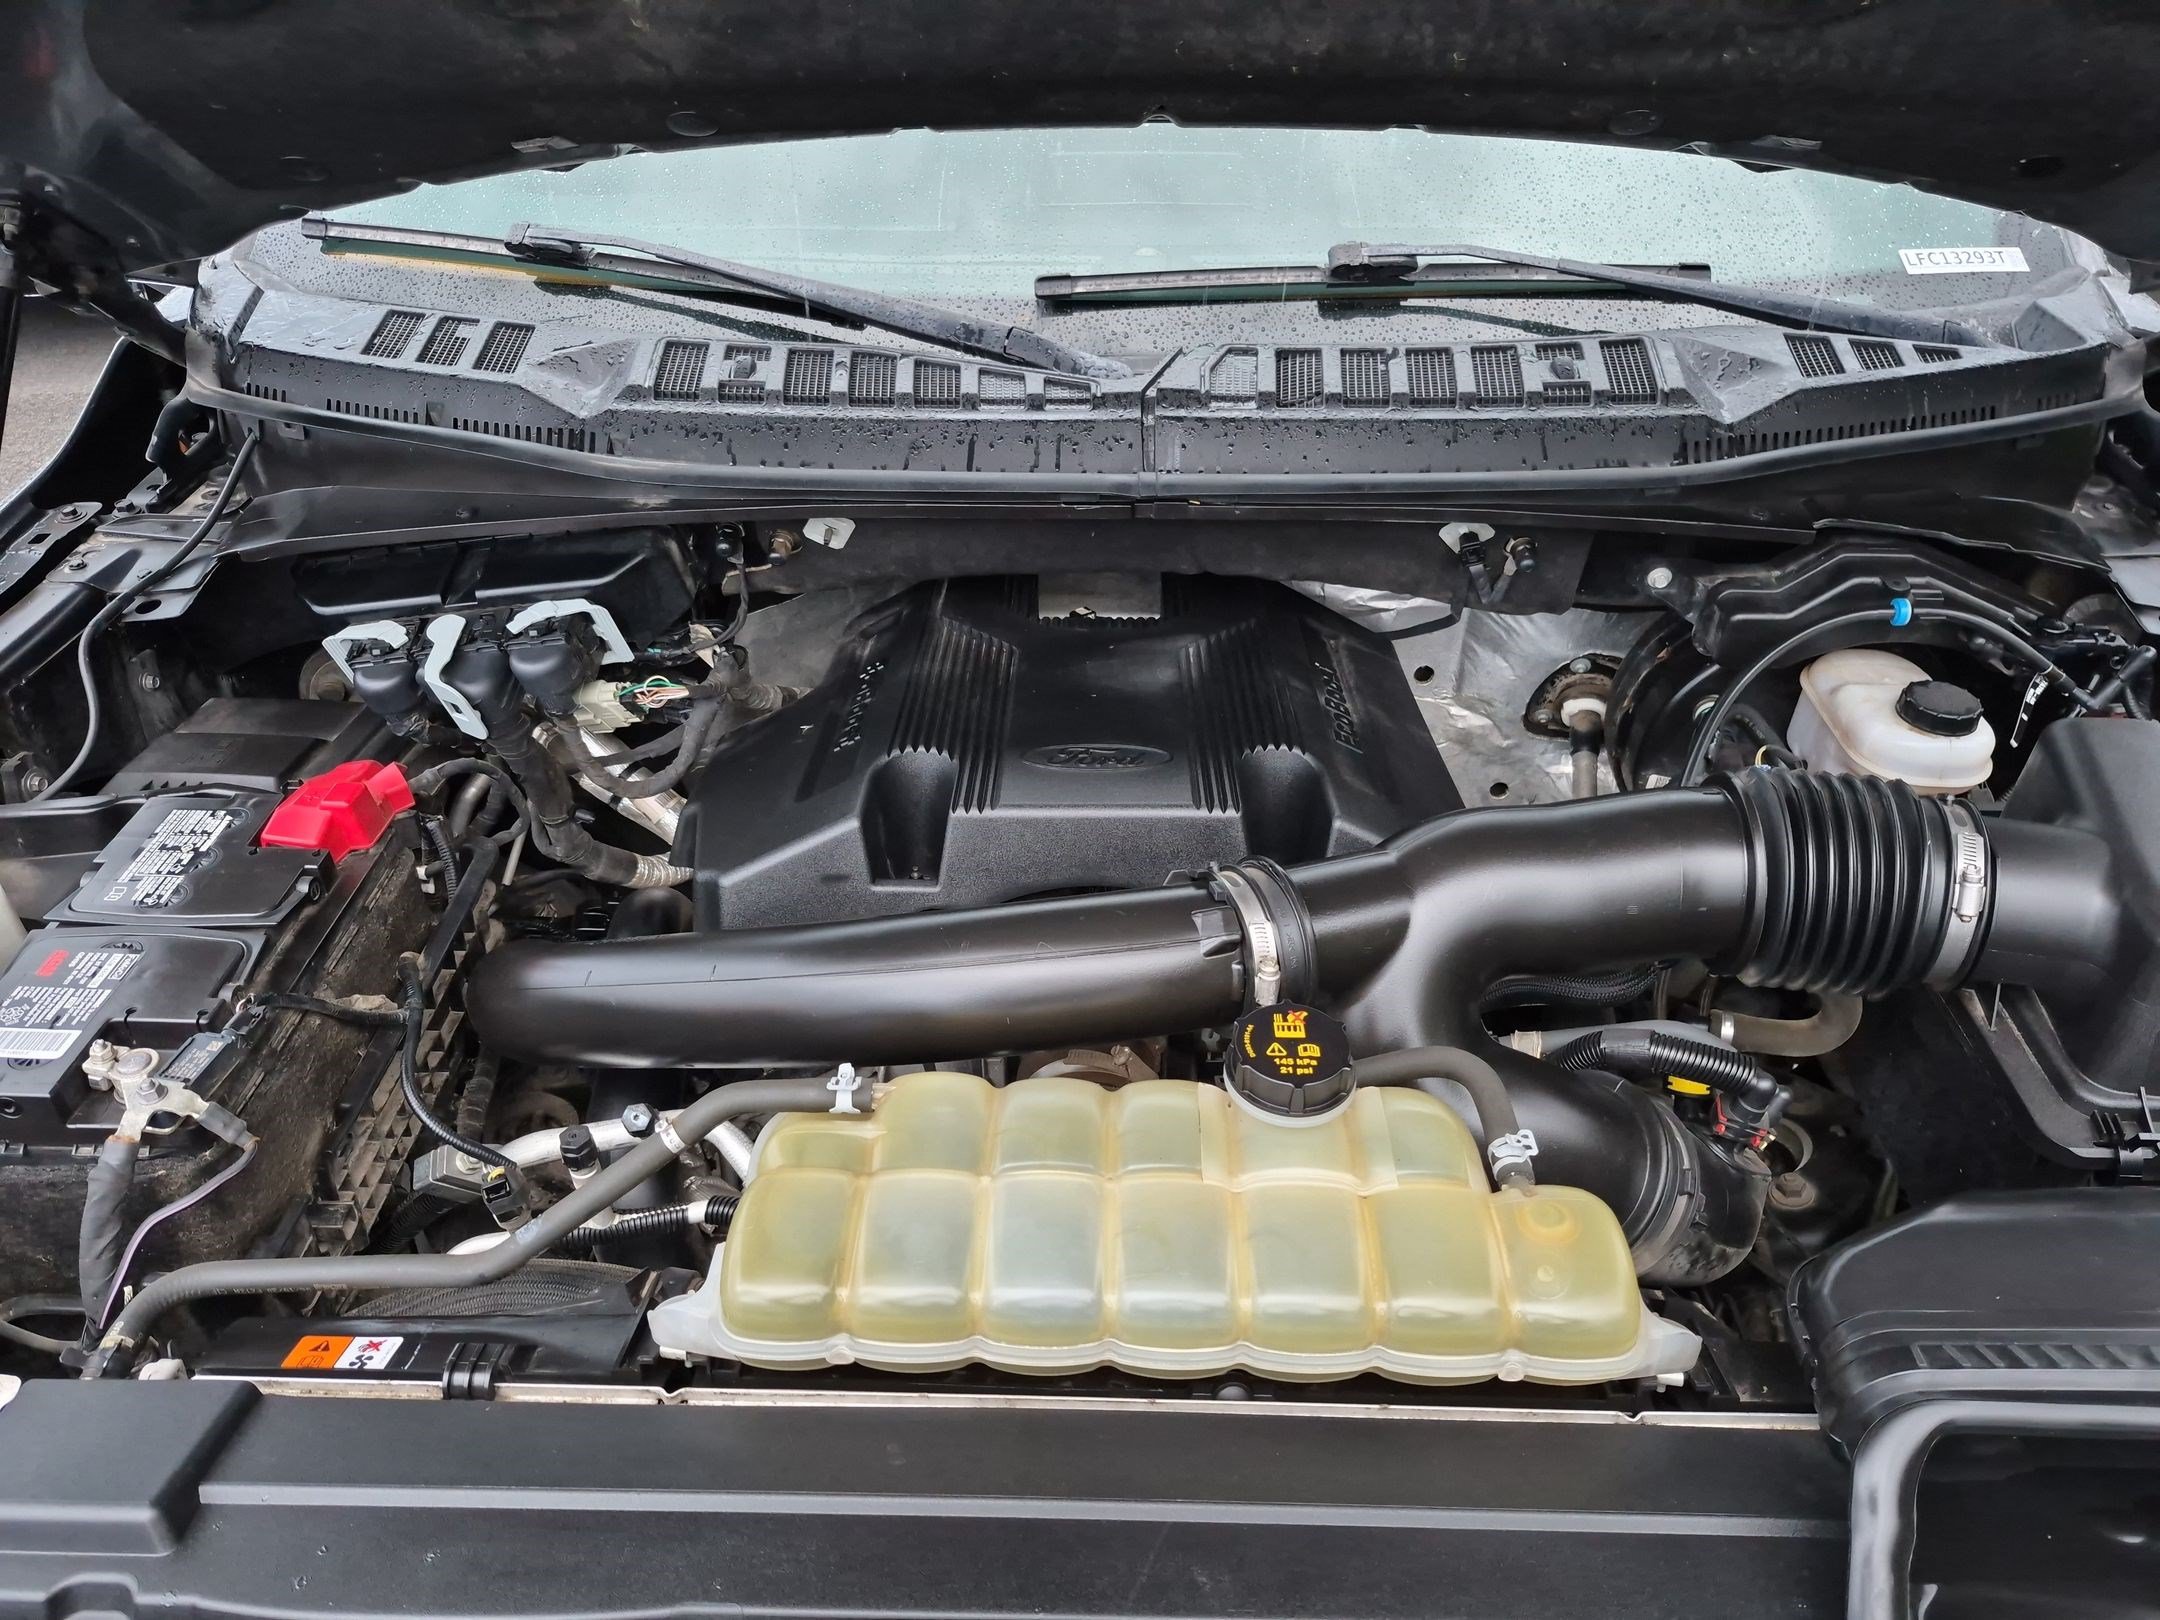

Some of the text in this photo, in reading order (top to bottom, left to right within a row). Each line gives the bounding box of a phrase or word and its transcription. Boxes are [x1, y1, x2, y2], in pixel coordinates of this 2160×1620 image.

[1904, 250, 2005, 266] LFC13293T
[1047, 747, 1144, 768] Ford
[1273, 1057, 1318, 1066] 145 kPa
[1279, 1066, 1314, 1076] 21 psi
